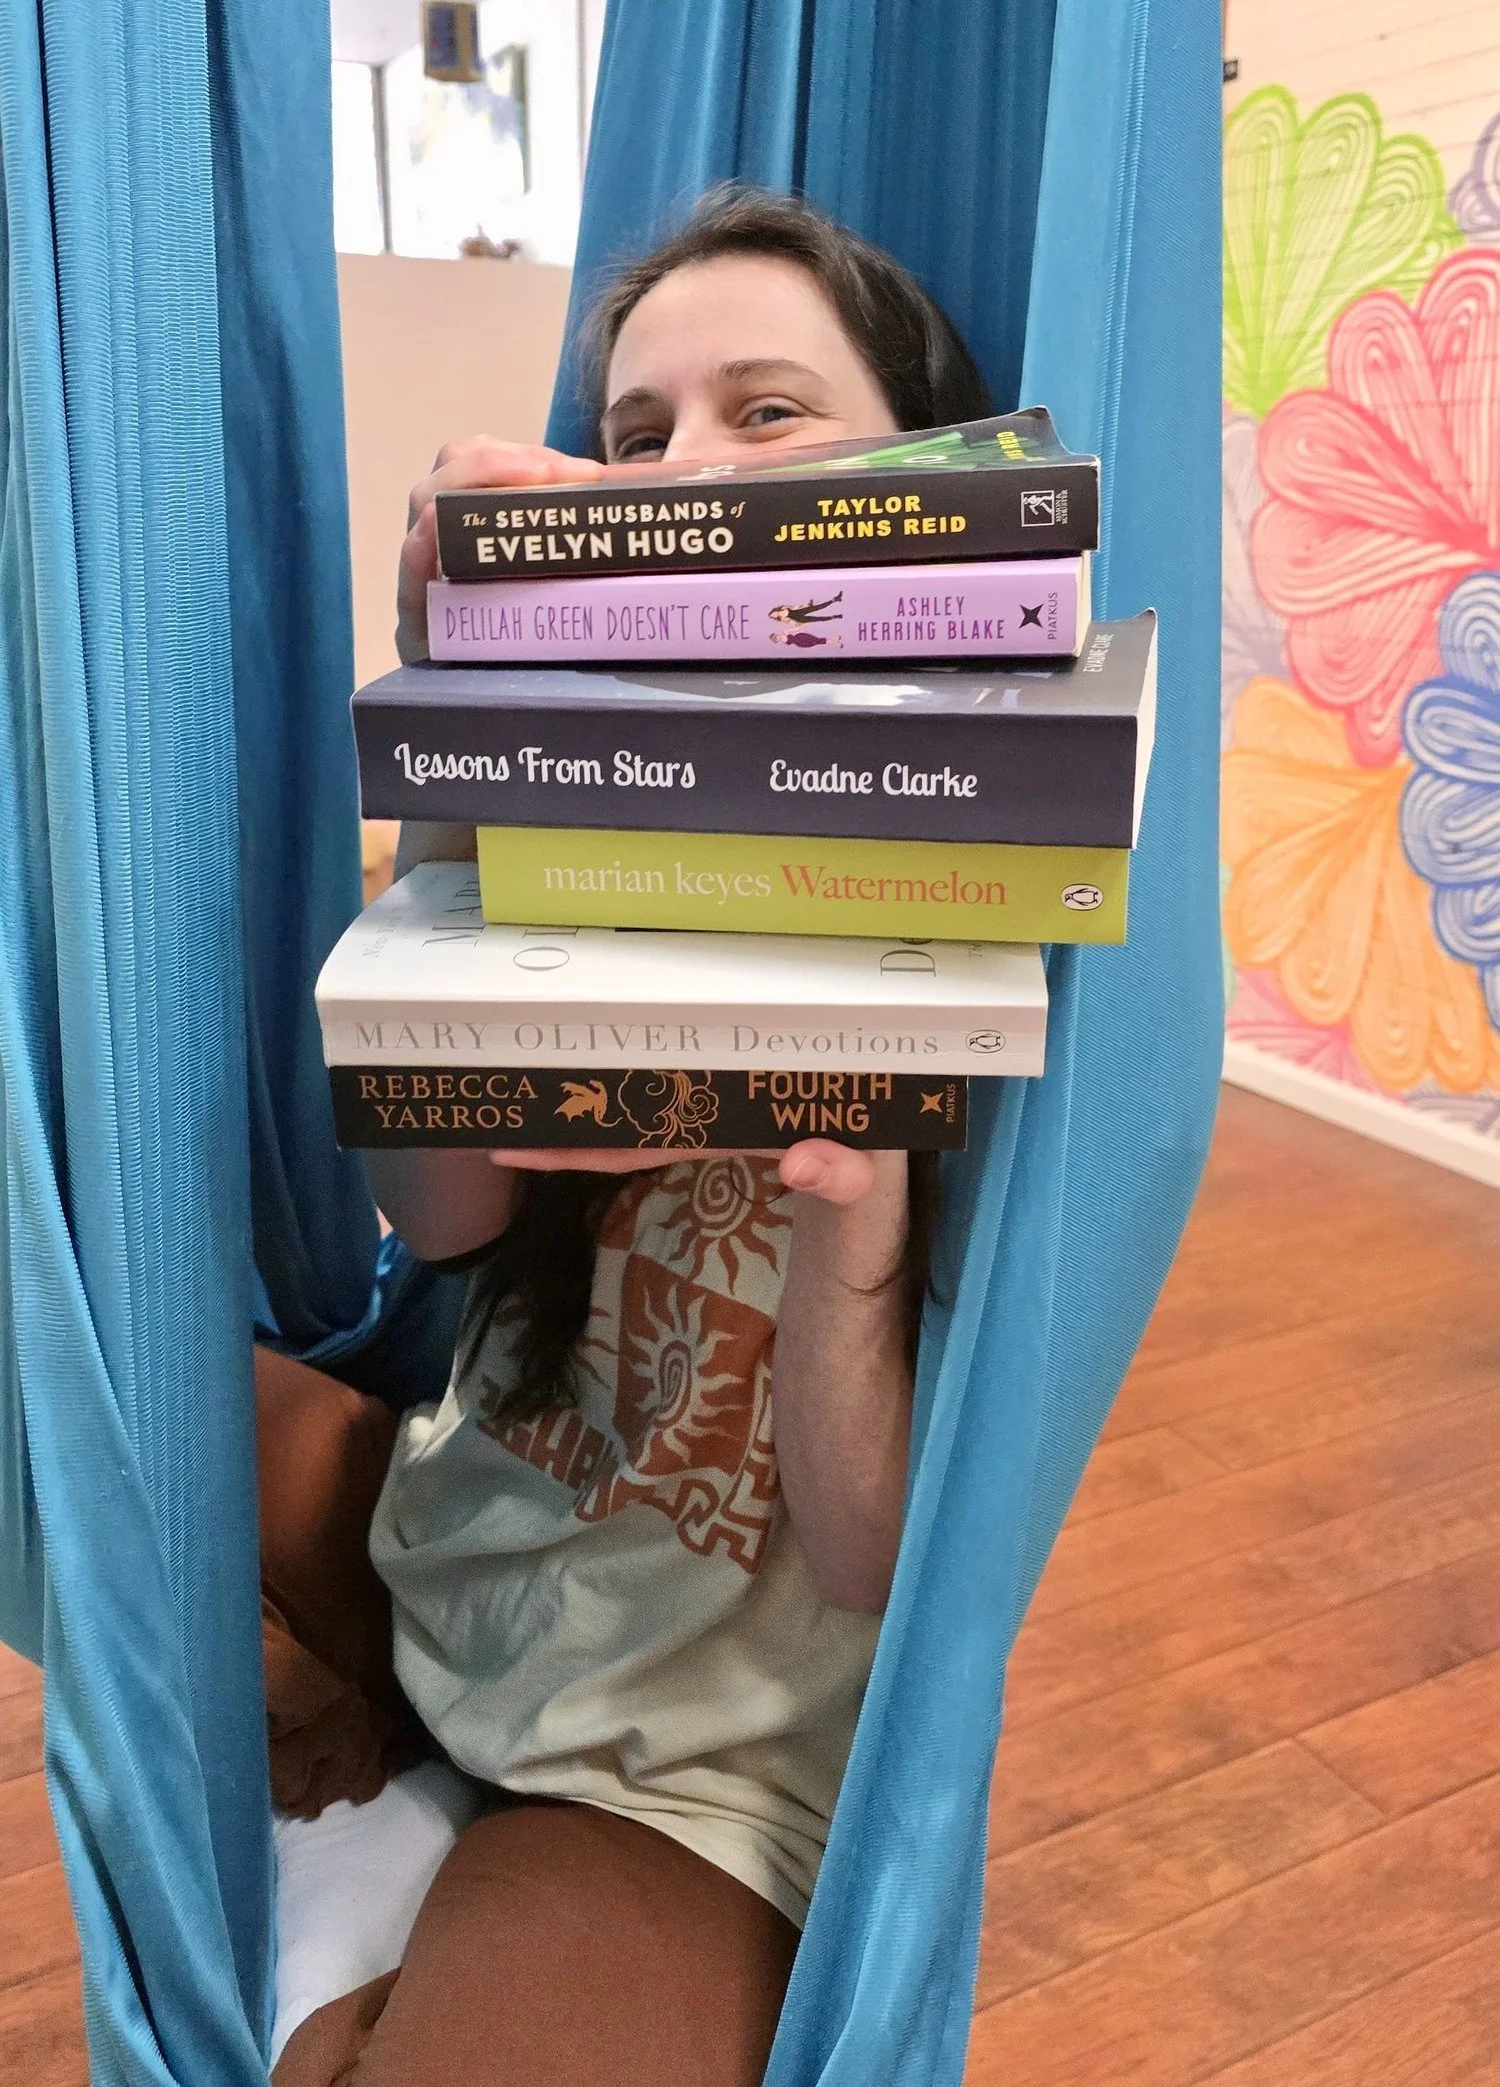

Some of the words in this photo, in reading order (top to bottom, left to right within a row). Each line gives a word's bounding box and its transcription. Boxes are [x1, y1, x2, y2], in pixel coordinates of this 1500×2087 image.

[462, 512, 487, 527] The
[495, 507, 577, 528] SEVEN
[588, 501, 724, 525] HUSBANDS
[730, 501, 746, 518] of
[817, 495, 922, 517] TAYLOR
[774, 519, 892, 542] JENKINS
[904, 515, 967, 536] REID
[476, 531, 613, 563] EVELYN
[627, 526, 734, 557] HUGO
[897, 596, 965, 617] ASHLEY
[1047, 592, 1058, 640] PIATKUS
[446, 606, 522, 641] DELILAH
[534, 605, 593, 641] GREEN
[607, 604, 689, 641] DOESN'T
[700, 604, 750, 641] CARE
[858, 621, 936, 641] HERRING
[948, 619, 1005, 640] BLAKE
[394, 742, 510, 786] Lessons
[517, 747, 605, 785] From
[613, 750, 696, 789] Stars
[769, 759, 873, 794] Evadne
[882, 762, 978, 798] Clarke
[544, 860, 665, 893] marian
[675, 862, 772, 905] keyes
[780, 864, 1007, 905] Watermelon
[355, 1022, 488, 1050] MARY
[514, 1022, 701, 1051] OLIVER
[733, 1024, 939, 1055] Devotions
[358, 1074, 538, 1100] REBECCA
[748, 1070, 892, 1100] FOURTH
[374, 1104, 525, 1129] YARROS
[770, 1102, 870, 1133] WING
[945, 1083, 956, 1123] PIATKUS
